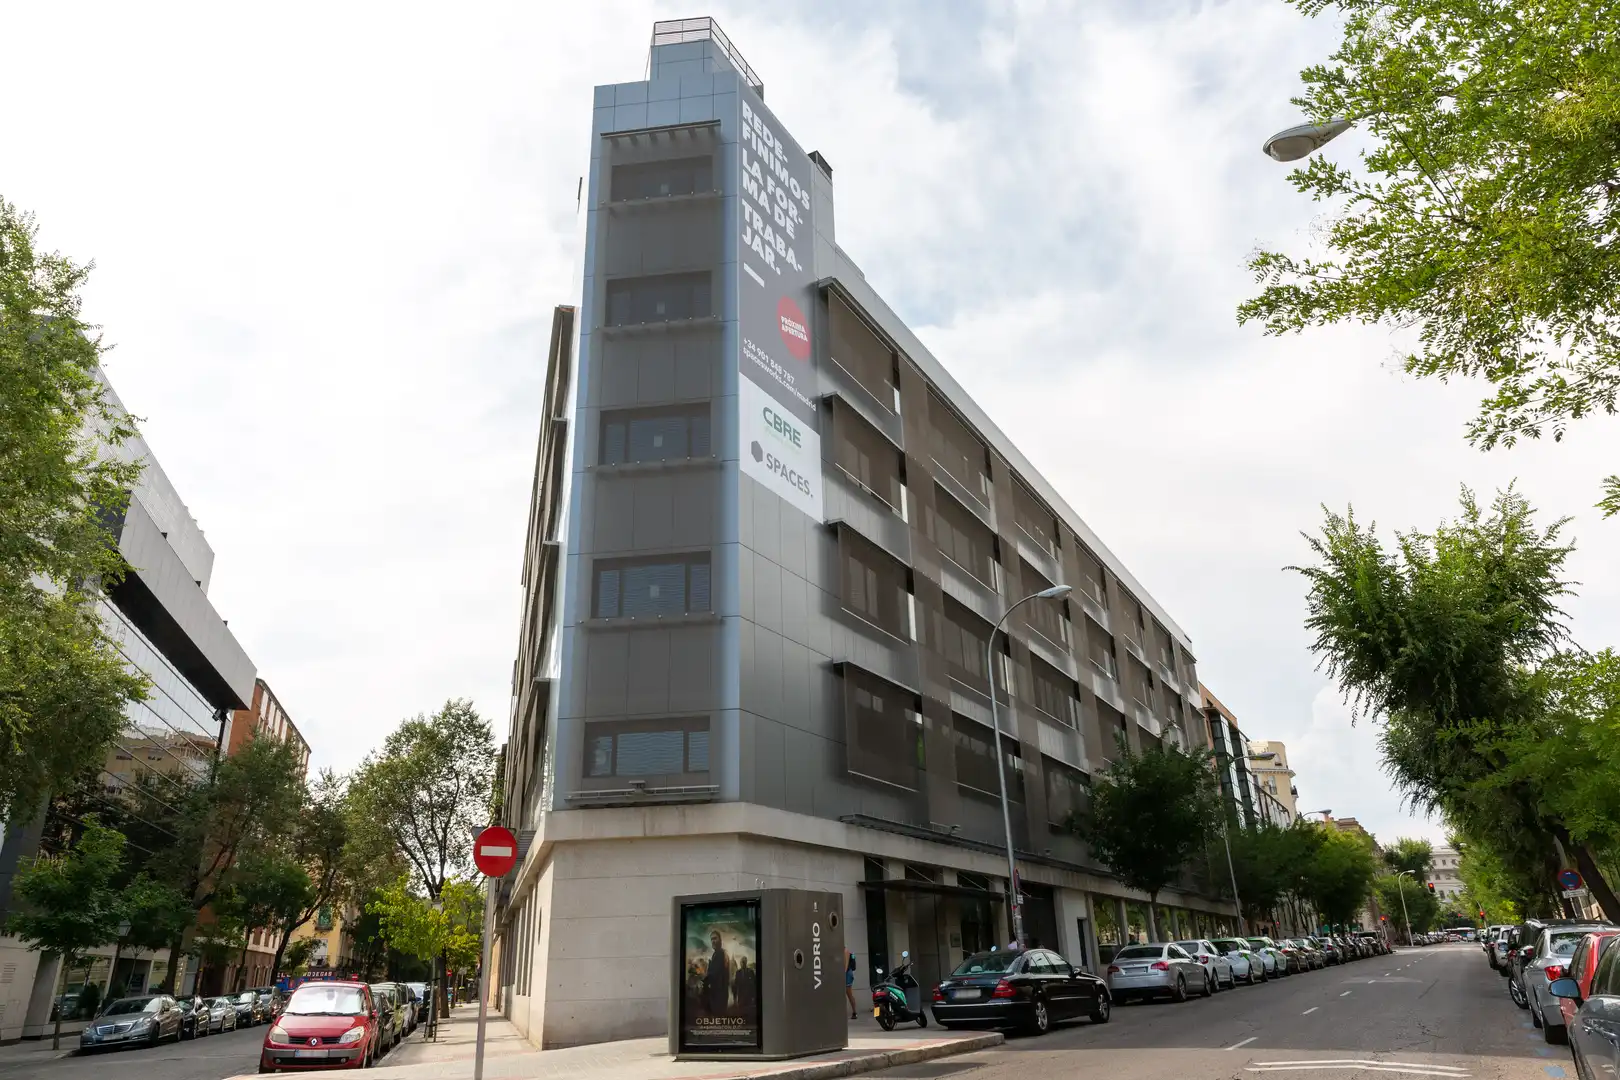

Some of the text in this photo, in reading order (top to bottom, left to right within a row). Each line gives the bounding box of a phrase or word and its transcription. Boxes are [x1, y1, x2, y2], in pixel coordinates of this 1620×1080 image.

[742, 99, 789, 163] REDE-
[742, 121, 811, 211] FINIMOS
[742, 148, 764, 186] LA
[742, 169, 796, 240] MA DE
[742, 226, 782, 276] JAR.
[743, 337, 756, 353] +34
[763, 406, 802, 449] CBRE
[766, 452, 814, 498] SPACES.
[812, 922, 823, 990] VIDRIO
